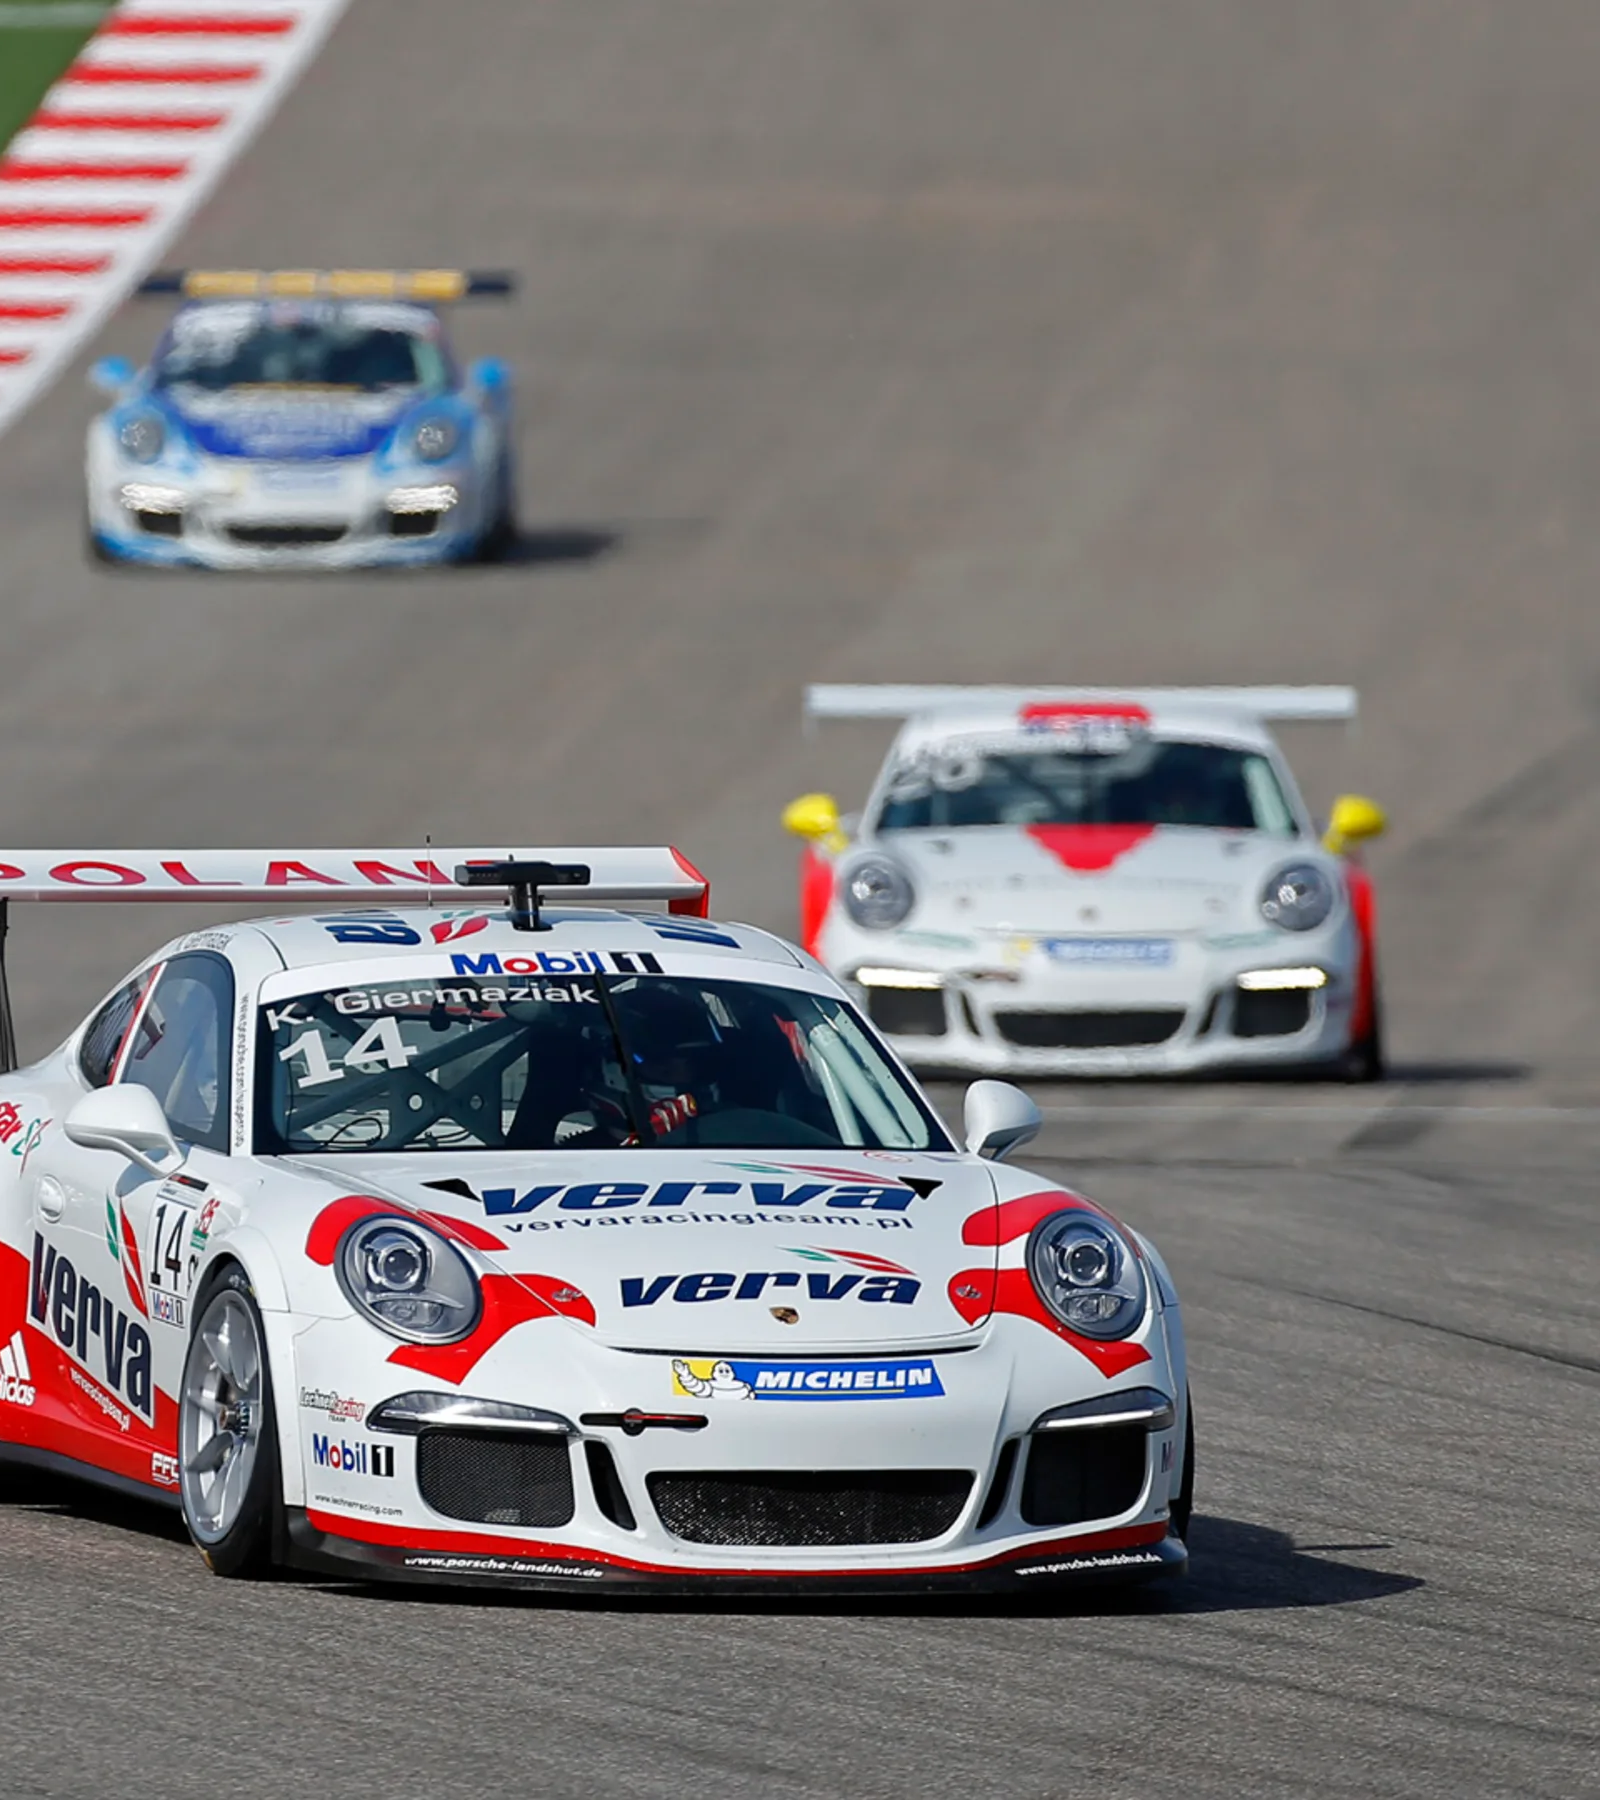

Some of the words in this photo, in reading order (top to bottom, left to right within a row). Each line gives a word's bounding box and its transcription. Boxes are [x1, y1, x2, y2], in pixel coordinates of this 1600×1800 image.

[450, 951, 607, 975] Mobil
[266, 1005, 314, 1031] K.
[335, 983, 599, 1016] Giermaziak
[279, 1016, 419, 1088] 14
[480, 1182, 919, 1216] verva
[504, 1210, 914, 1233] vervaracingteam.pl
[150, 1203, 188, 1291] 14
[620, 1272, 922, 1307] verva
[31, 1230, 151, 1417] verva
[755, 1368, 933, 1389] MICHELIN
[313, 1433, 366, 1474] Mobil
[404, 1556, 604, 1578] www.porsche-landshut.de
